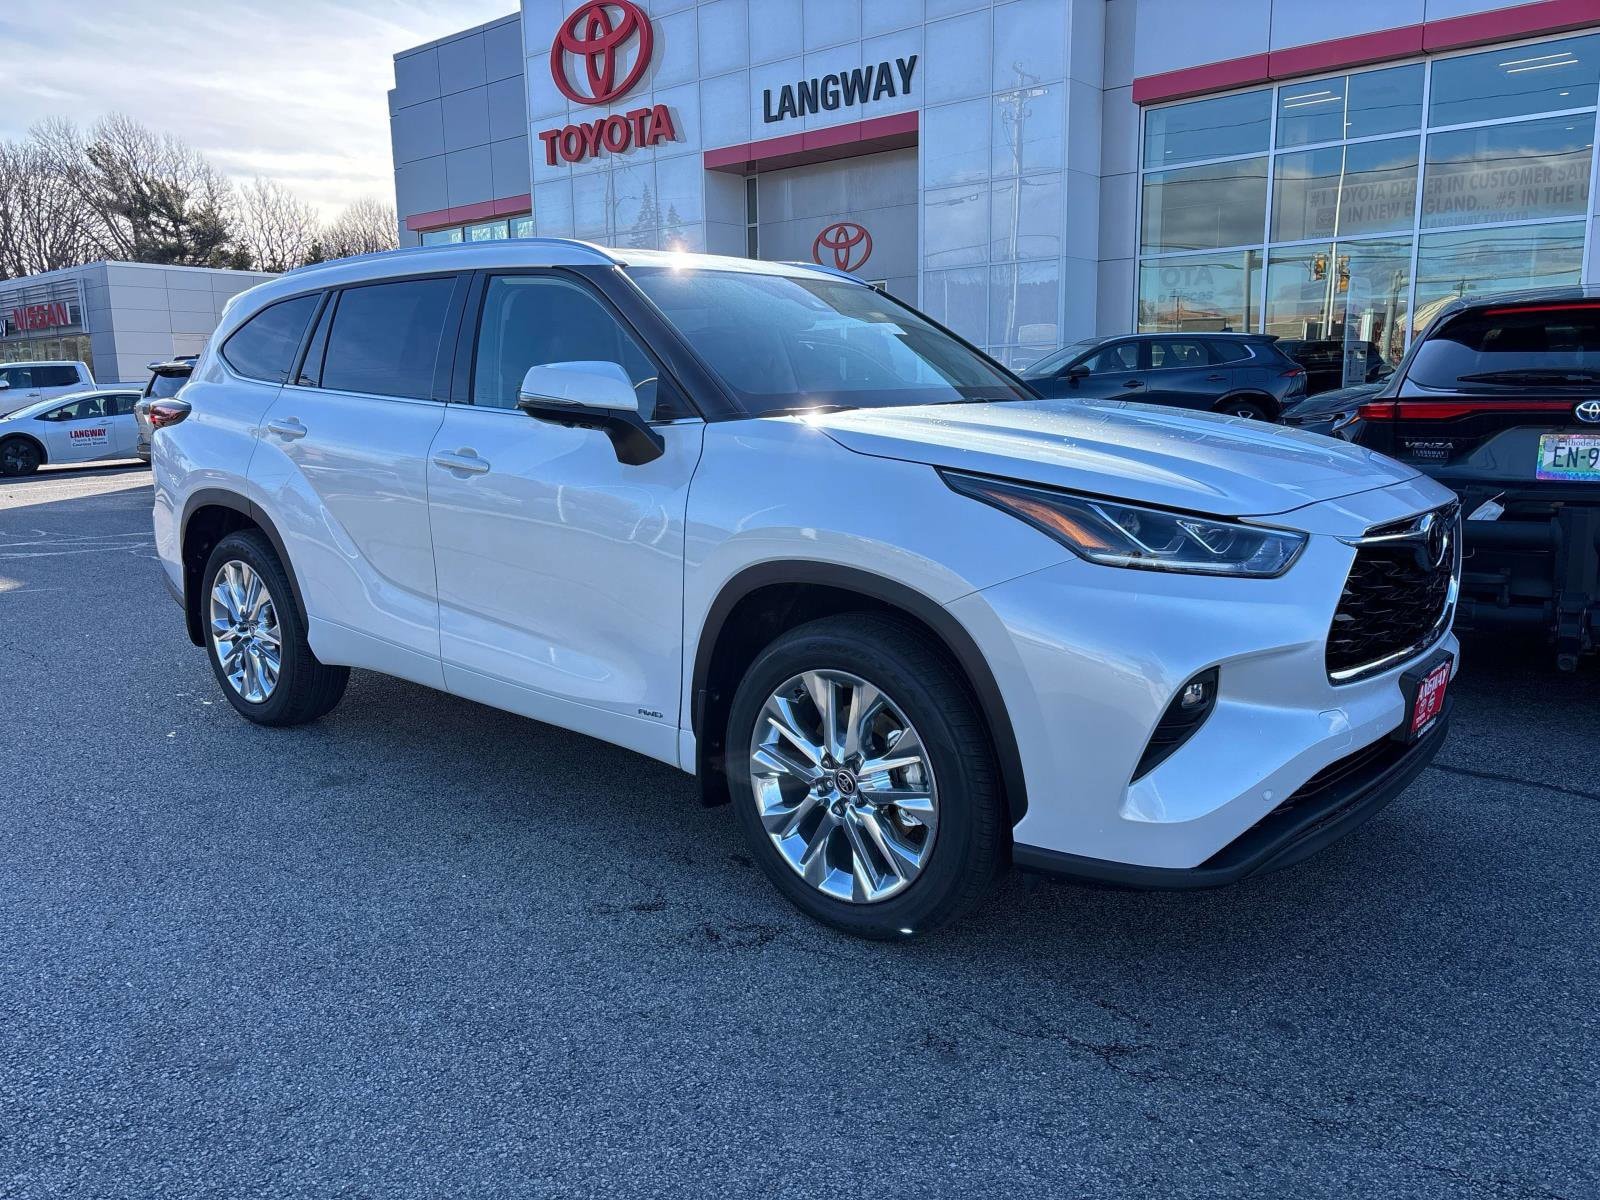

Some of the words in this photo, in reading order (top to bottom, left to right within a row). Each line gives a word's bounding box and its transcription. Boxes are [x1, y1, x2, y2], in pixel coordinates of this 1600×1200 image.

[764, 55, 917, 123] LANGWAY
[539, 104, 676, 166] TOYOTA
[1390, 178, 1442, 198] DEAER
[1447, 175, 1464, 193] IN
[1469, 167, 1552, 190] CUSTOMER
[1347, 206, 1363, 223] IN
[1368, 200, 1400, 221] NEW
[1496, 190, 1517, 208] #5
[1521, 188, 1539, 207] IN
[1544, 184, 1576, 205] THE
[13, 303, 70, 330] NISSAN
[70, 428, 106, 439] LANGWAY
